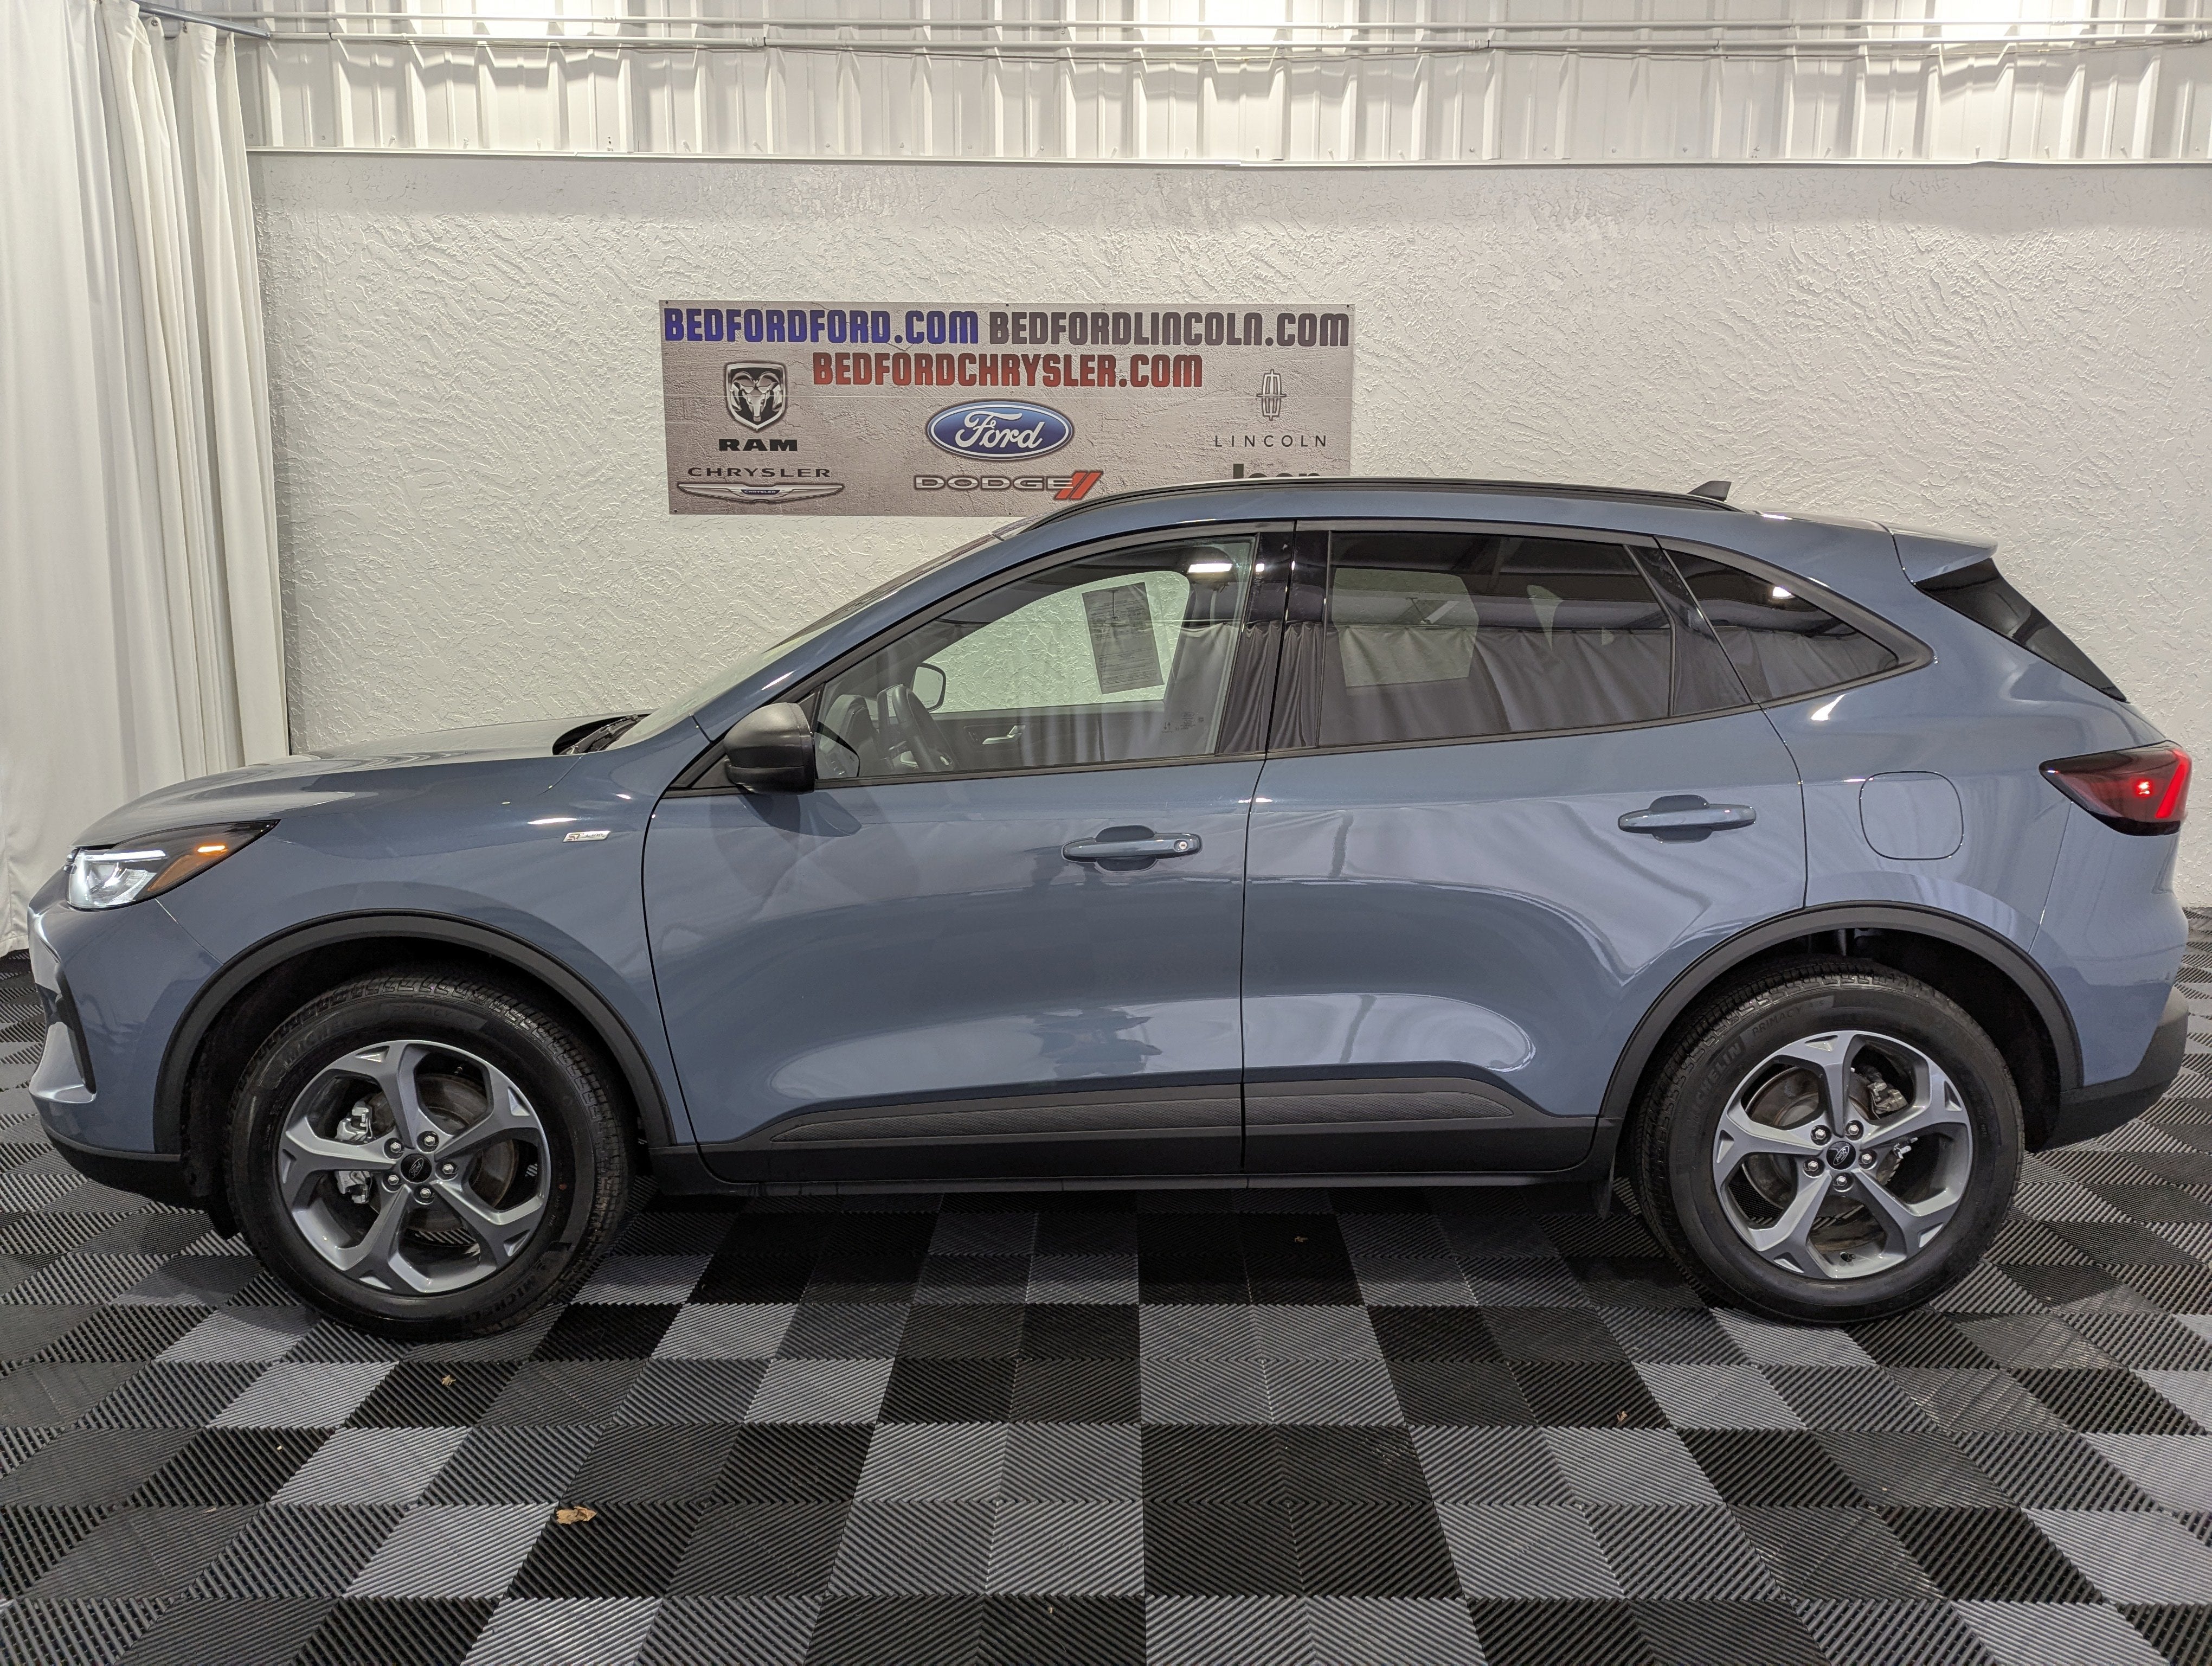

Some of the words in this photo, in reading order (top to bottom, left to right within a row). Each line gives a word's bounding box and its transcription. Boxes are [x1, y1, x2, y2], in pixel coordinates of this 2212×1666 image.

[664, 308, 979, 344] BEDFORDFORD.COM
[989, 311, 1349, 347] BEDFORDLINCOLN.COM
[813, 352, 1203, 387] BEDFORDCHRYSLER.COM
[955, 410, 1045, 448] Ford
[719, 438, 798, 451] RAM
[1215, 435, 1326, 447] LINCOLN
[687, 467, 831, 477] CHRYSLER
[915, 477, 1075, 489] DODGE
